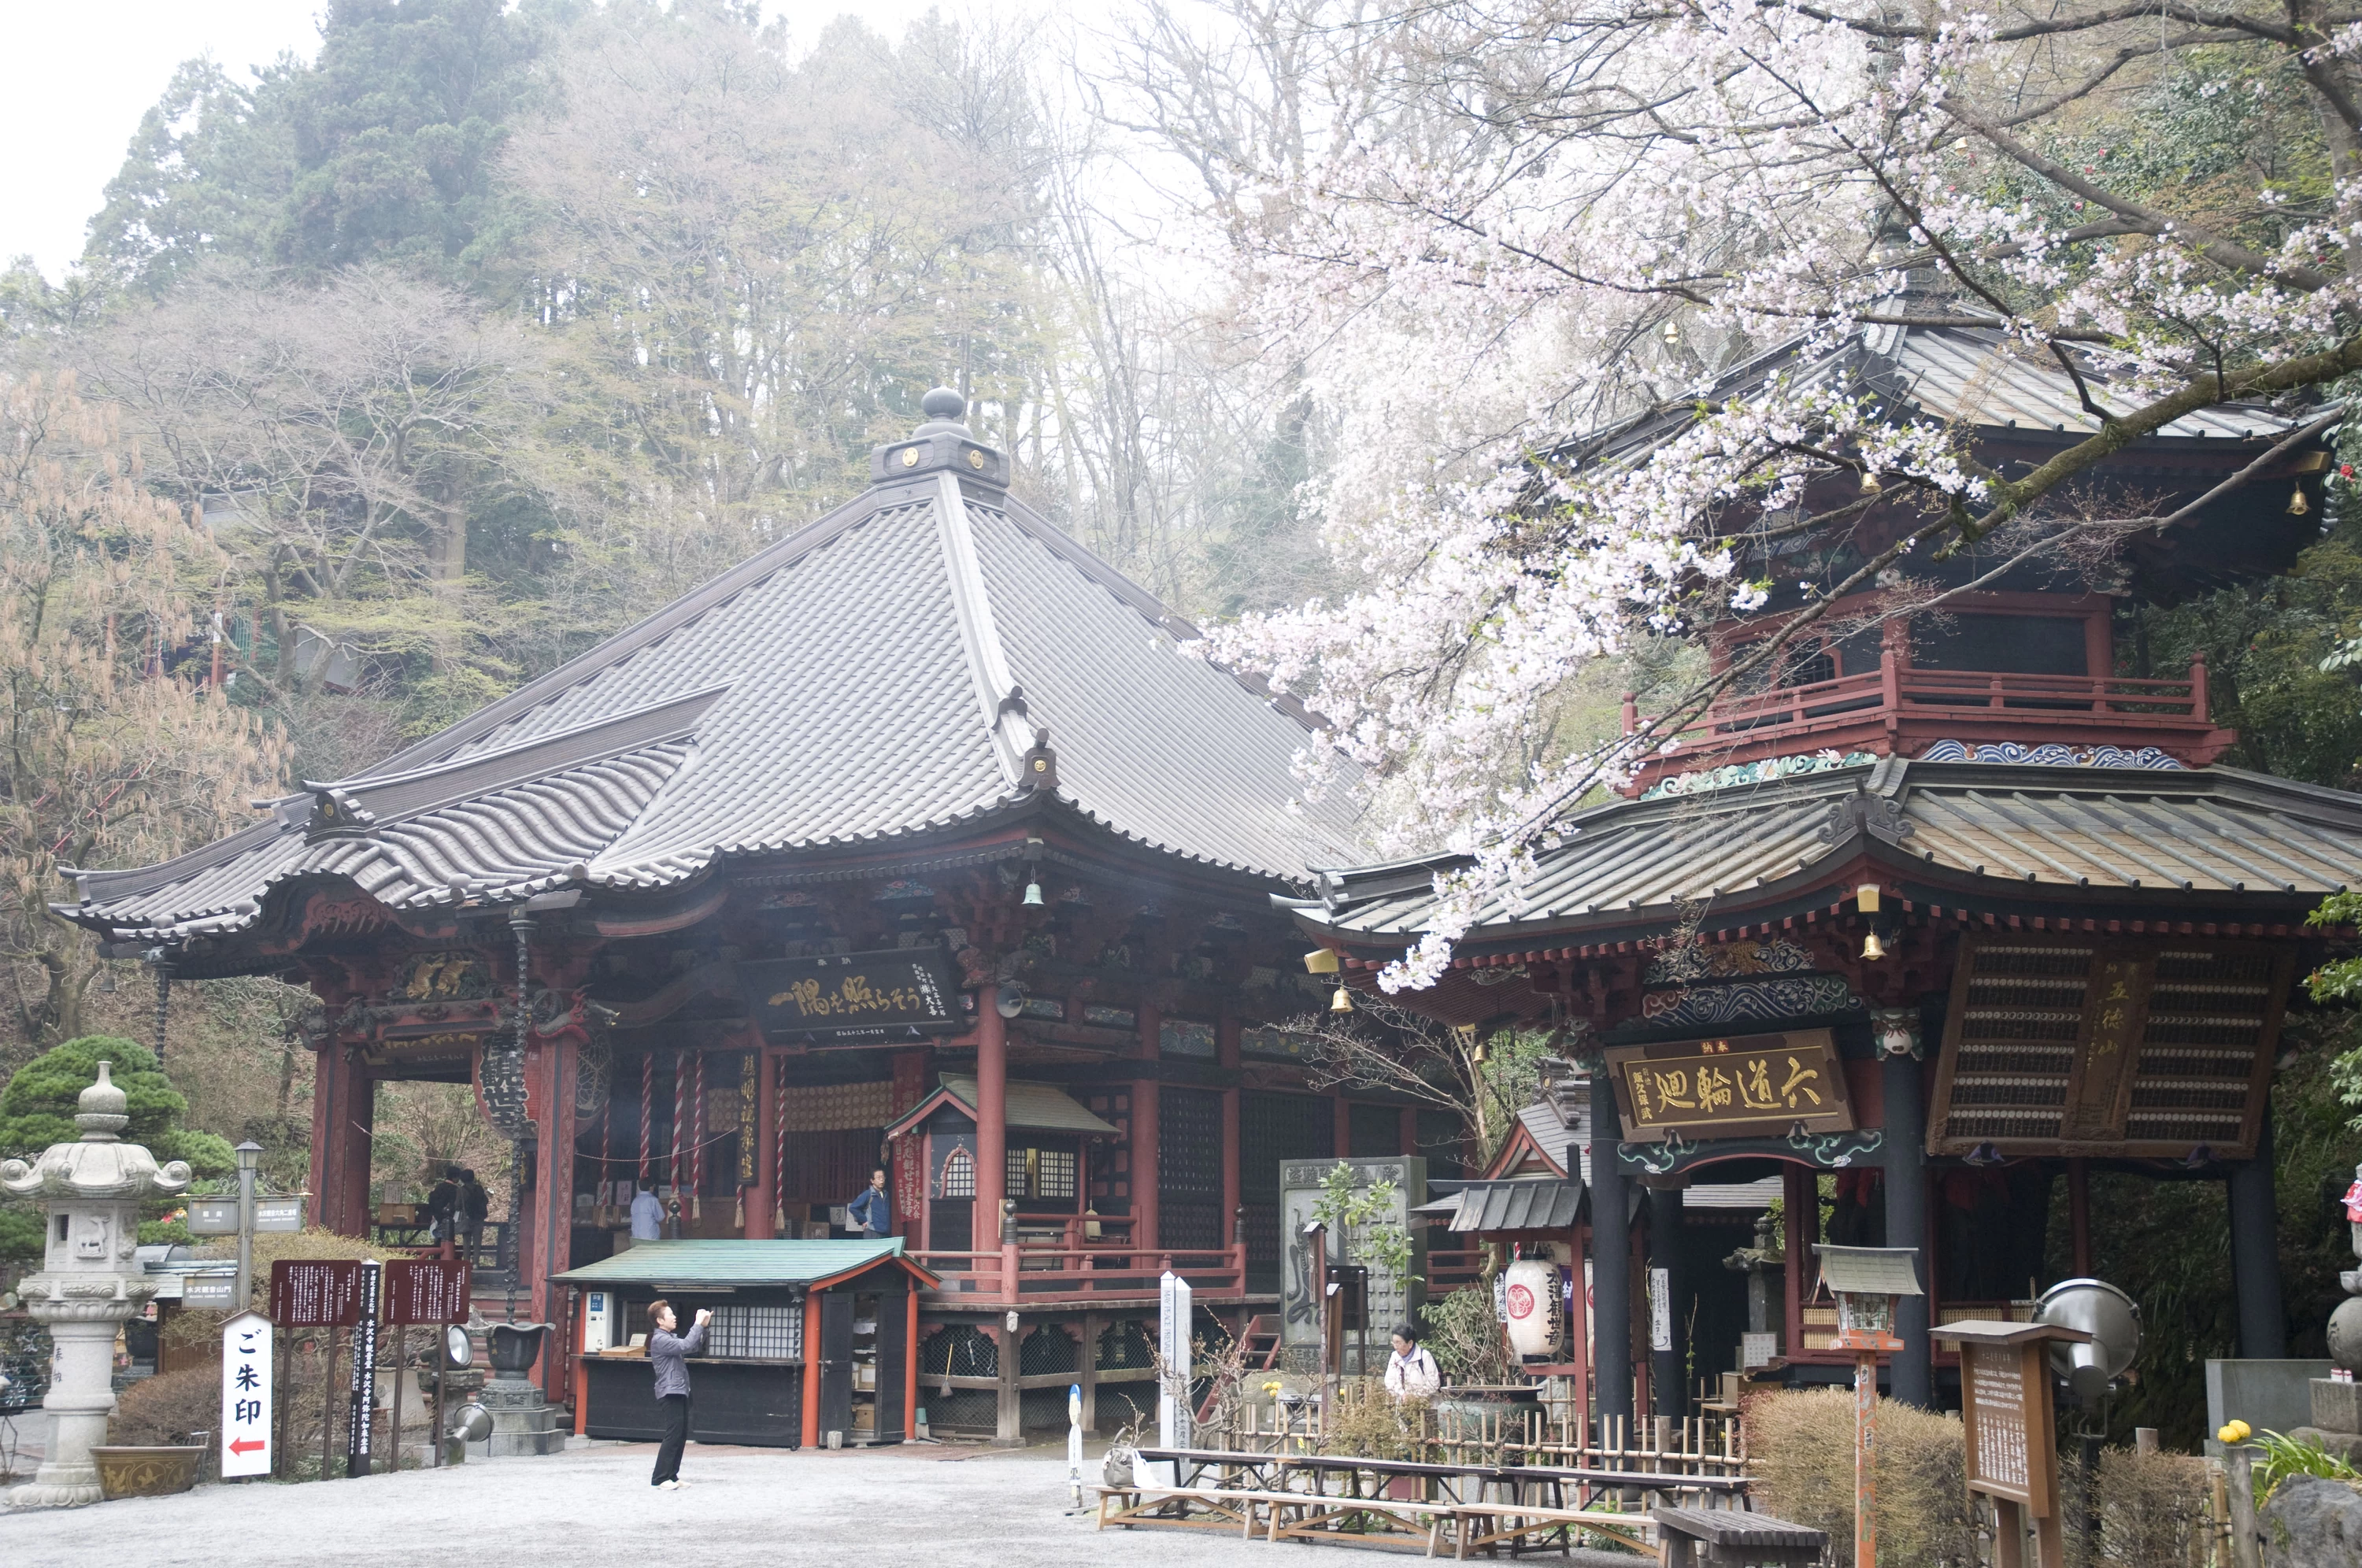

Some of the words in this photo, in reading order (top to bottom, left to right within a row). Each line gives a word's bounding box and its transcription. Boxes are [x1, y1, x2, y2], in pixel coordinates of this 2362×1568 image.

[1701, 1041, 1729, 1053] 奉納
[365, 1318, 375, 1369] 水沢寺観音堂
[235, 1329, 262, 1426] ご朱印
